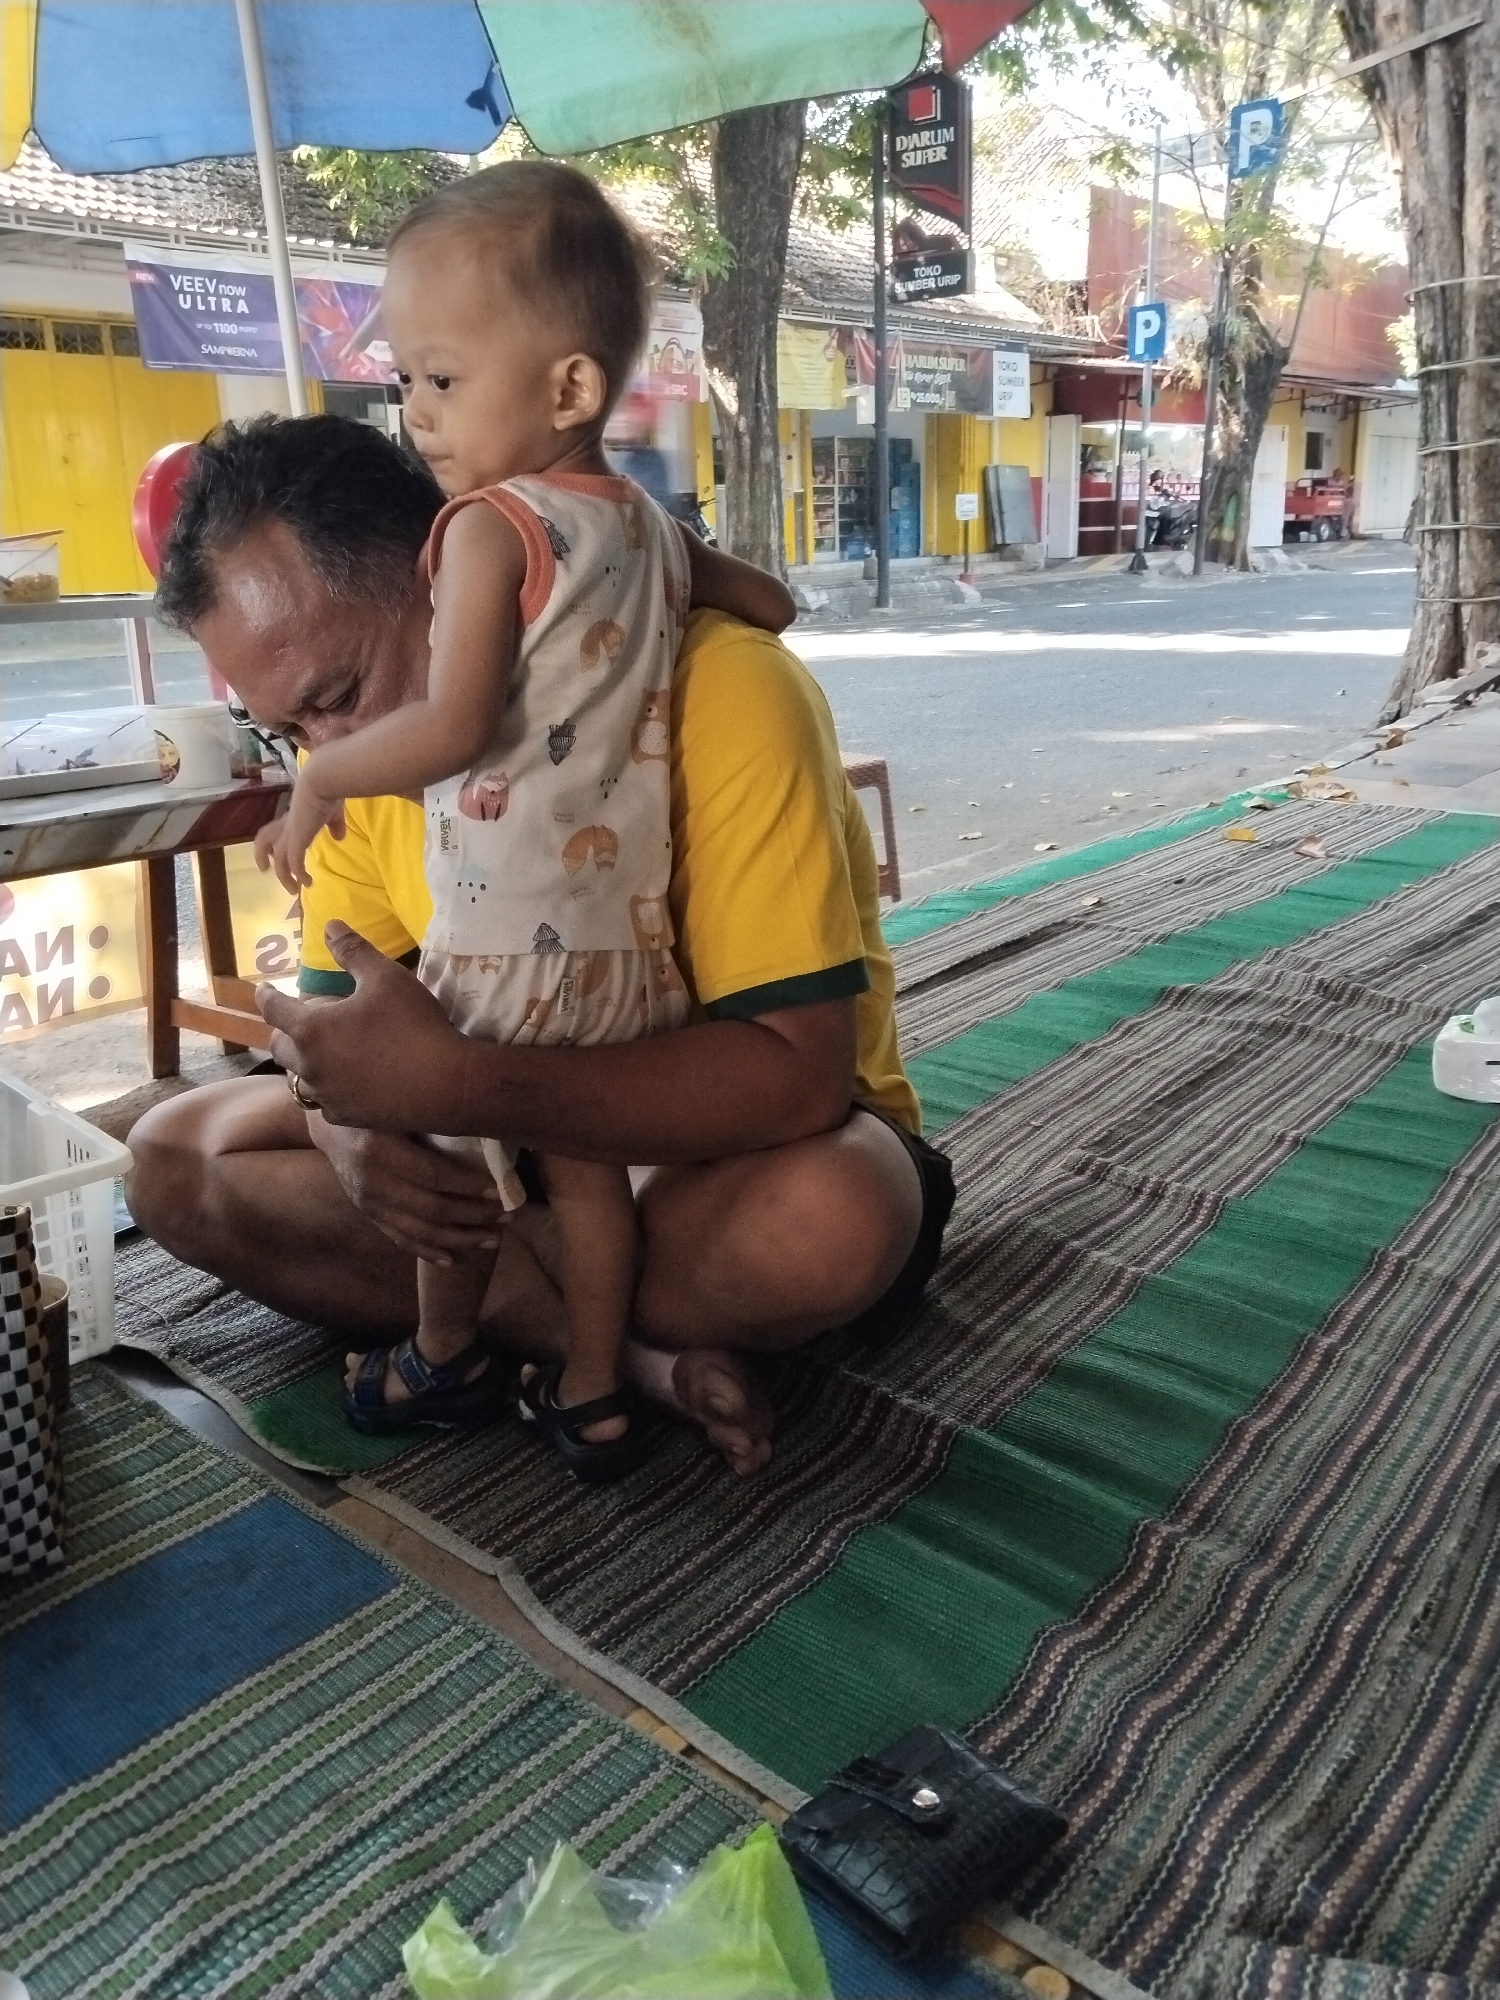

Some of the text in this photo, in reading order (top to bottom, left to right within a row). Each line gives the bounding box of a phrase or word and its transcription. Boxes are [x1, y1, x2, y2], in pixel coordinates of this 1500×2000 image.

[895, 126, 955, 152] DJARUM
[1233, 108, 1274, 175] P
[901, 146, 948, 168] SUPER
[913, 264, 942, 278] TOKO
[170, 274, 246, 297] VEEV now
[894, 274, 961, 293] SUMBER URIP
[178, 294, 249, 314] ULTRA
[213, 322, 238, 335] 1100
[1134, 310, 1161, 355] P
[997, 360, 1019, 372] TOKO
